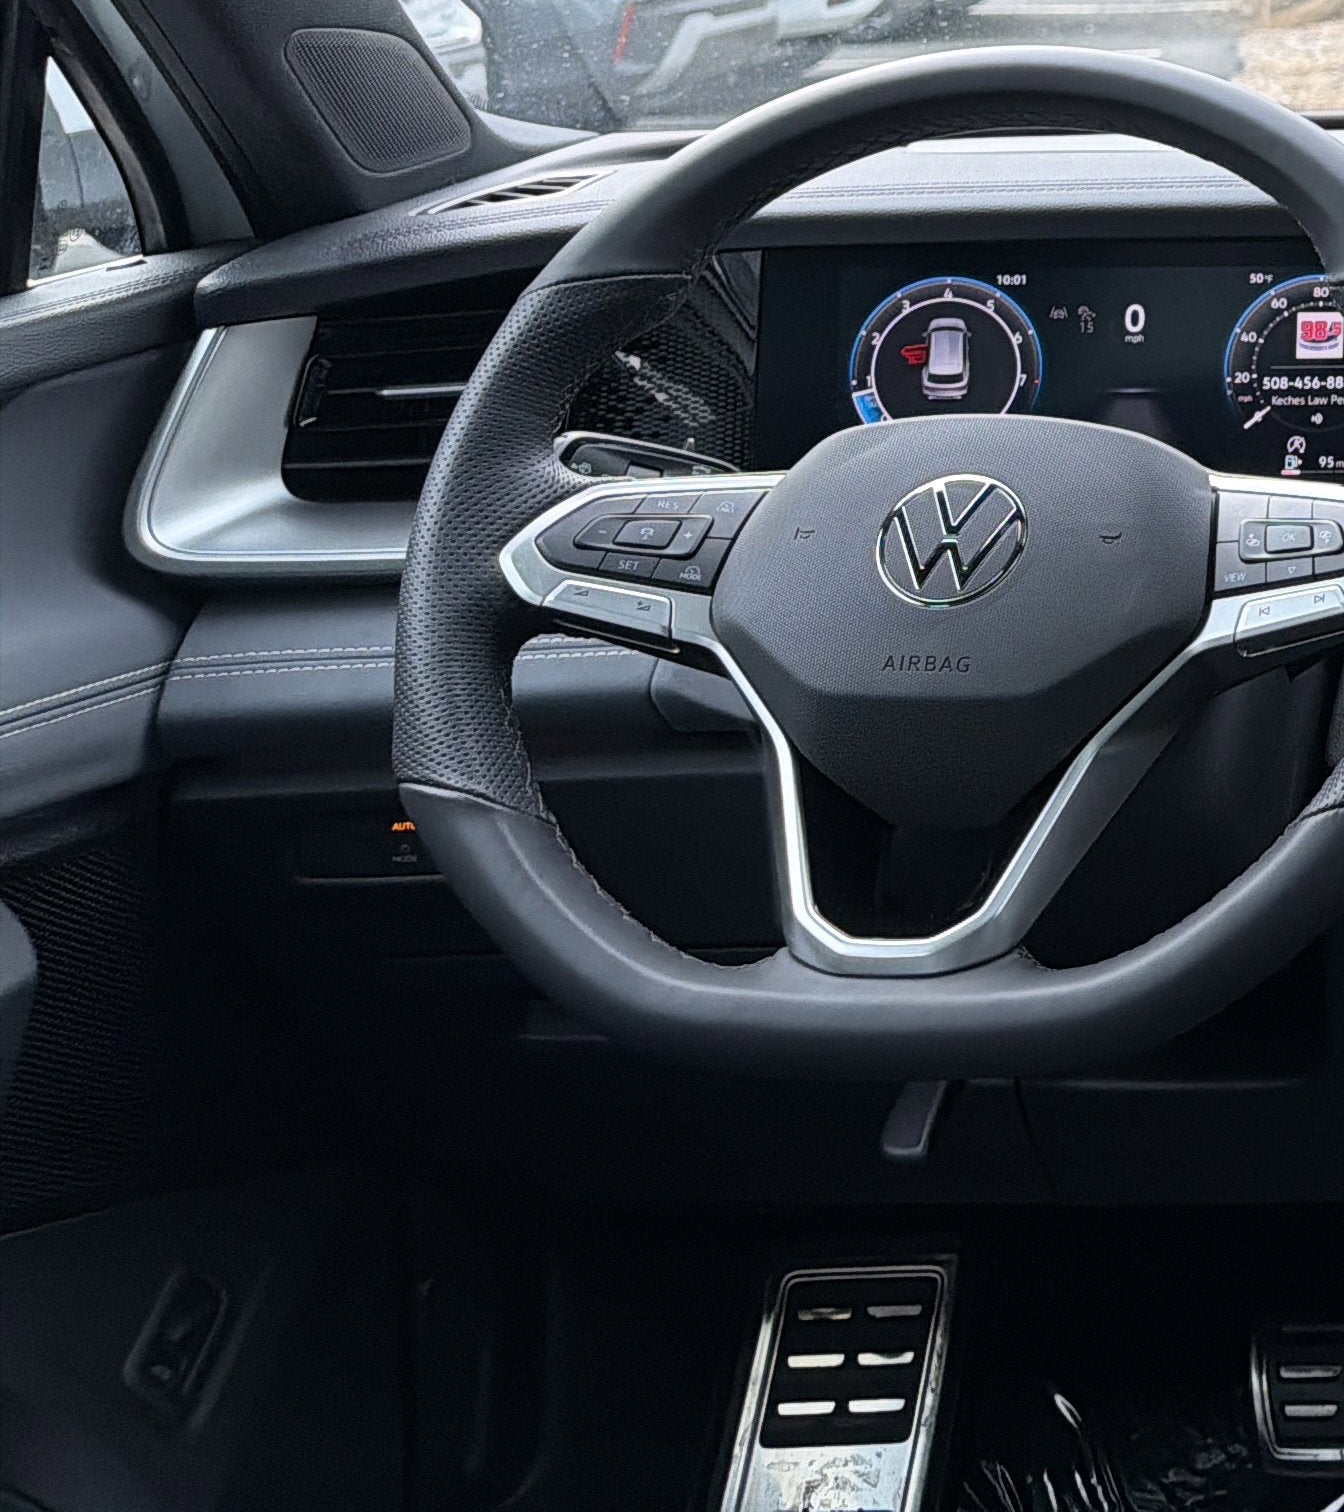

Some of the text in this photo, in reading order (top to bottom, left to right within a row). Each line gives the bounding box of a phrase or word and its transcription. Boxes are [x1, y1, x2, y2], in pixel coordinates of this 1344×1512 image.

[996, 274, 1027, 285] 10:01
[943, 288, 953, 298] 4
[1312, 287, 1330, 298] 80
[902, 300, 910, 312] 3
[986, 300, 995, 312] 5
[1270, 297, 1288, 309] 60
[1124, 303, 1146, 333] 0
[1080, 322, 1094, 334] 15
[872, 332, 880, 344] 2
[1014, 332, 1022, 344] 6
[1124, 334, 1145, 344] mph
[1240, 331, 1257, 343] 40
[866, 376, 872, 386] 1
[1019, 373, 1027, 386] 7
[1234, 372, 1250, 384] 20
[1238, 394, 1253, 402] mph
[1271, 395, 1305, 405] Keches
[1308, 395, 1328, 405] Law
[1319, 456, 1335, 468] 95
[657, 500, 680, 509] RES
[1282, 532, 1296, 543] OK
[619, 559, 639, 570] SET
[679, 572, 702, 581] MODE
[1224, 572, 1247, 583] VIEW
[881, 655, 970, 673] AIRBAG
